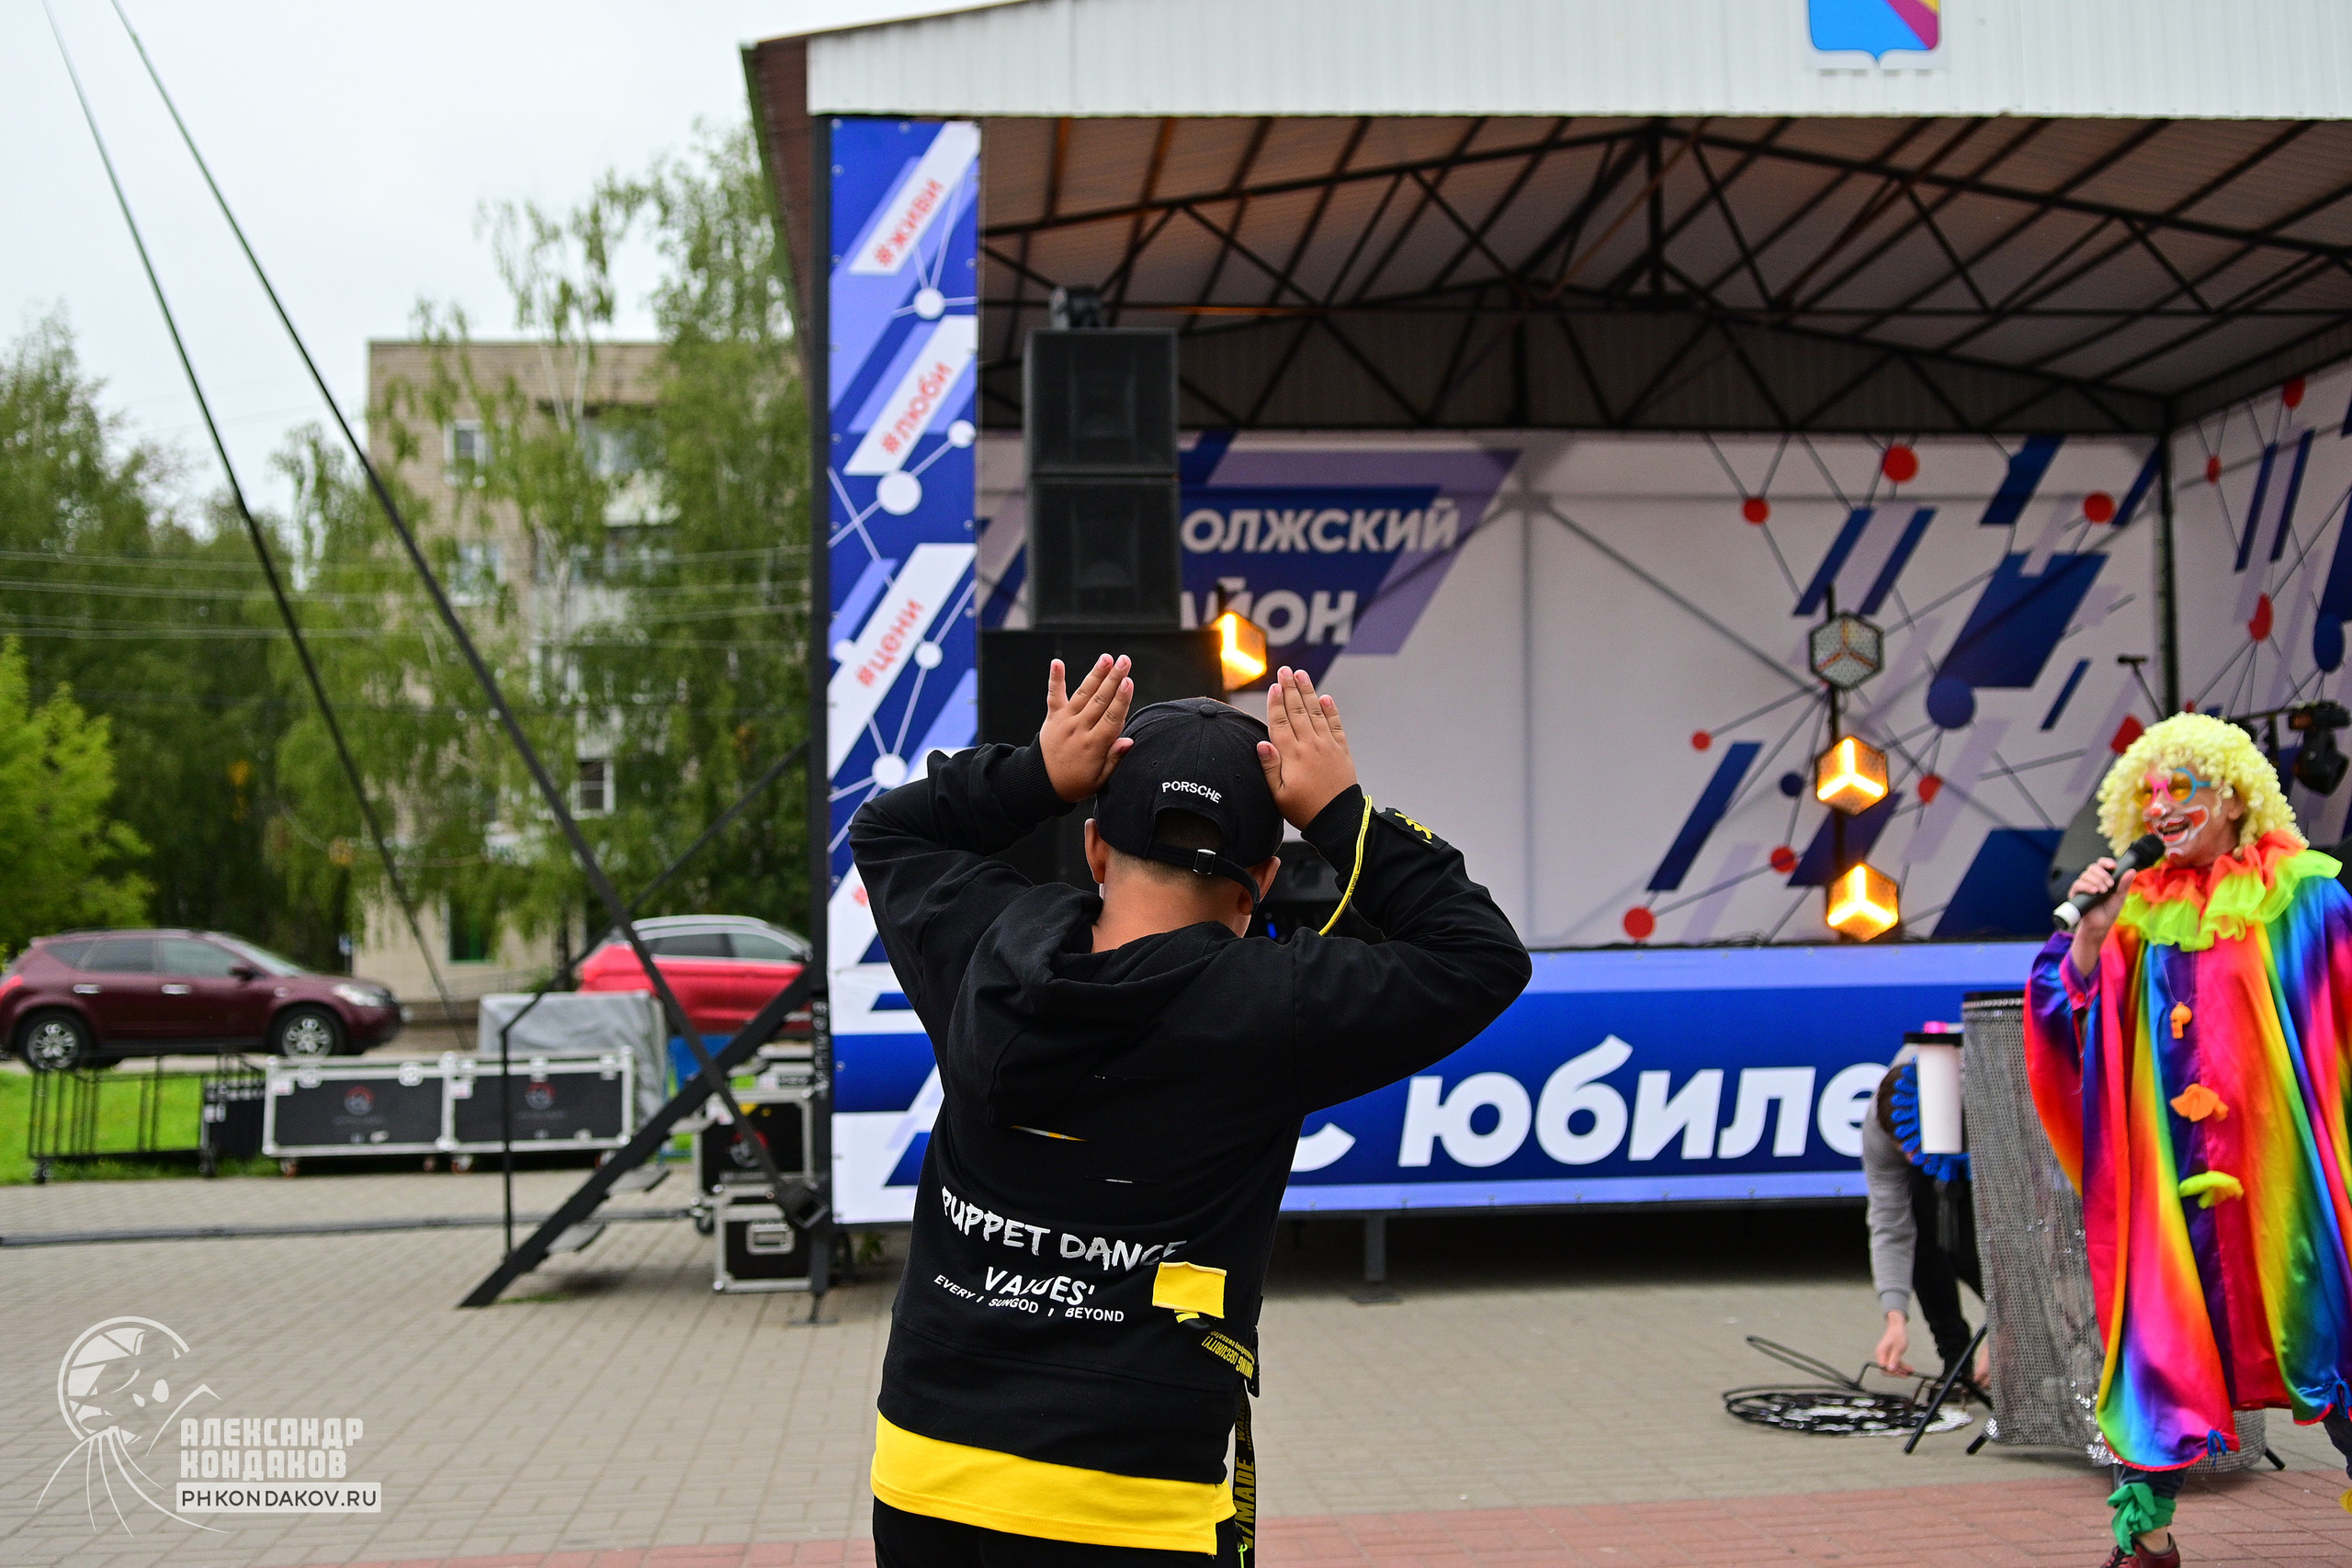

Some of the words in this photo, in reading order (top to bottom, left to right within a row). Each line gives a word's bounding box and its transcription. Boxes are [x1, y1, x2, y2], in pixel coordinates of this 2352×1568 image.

[1181, 498, 1460, 554] ОЛЖСКИЙ
[1161, 781, 1222, 805] PORSCHE
[1398, 1034, 1890, 1168] юбиле
[942, 1186, 1050, 1257] PUPPET
[933, 1274, 976, 1303] EVERY
[989, 1298, 1039, 1314] SUNGOD
[1065, 1307, 1125, 1323] BEYOND
